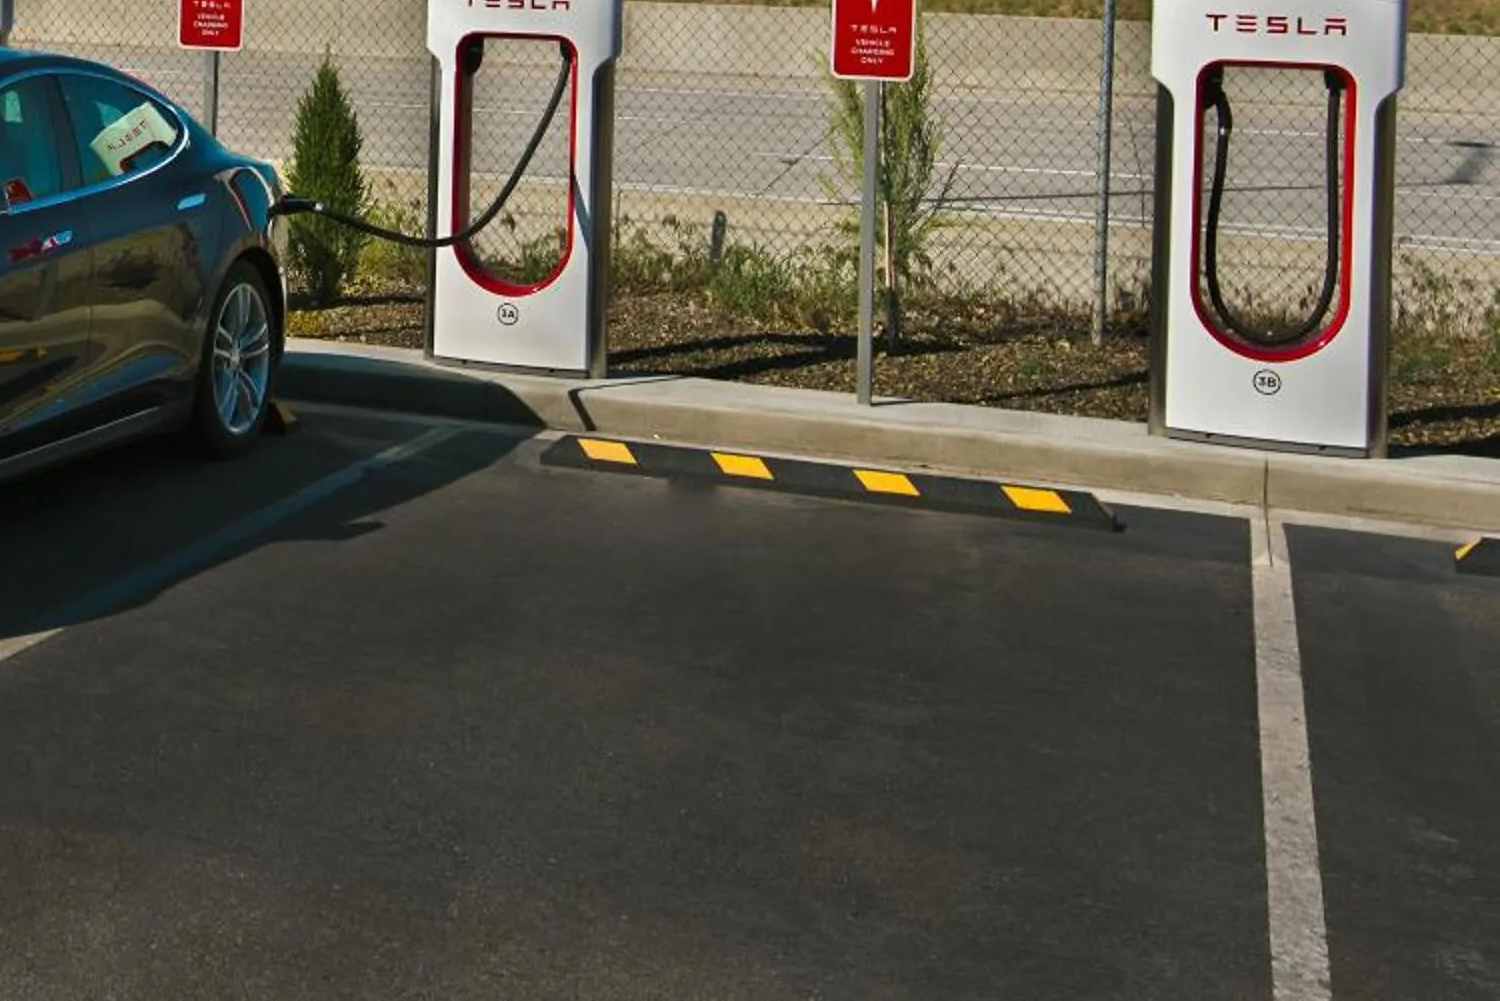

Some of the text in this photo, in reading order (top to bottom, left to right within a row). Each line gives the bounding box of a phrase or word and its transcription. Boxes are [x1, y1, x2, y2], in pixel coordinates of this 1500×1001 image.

[192, 0, 231, 9] TESLA
[850, 24, 897, 34] TESLA
[1205, 14, 1347, 36] TESLA
[855, 38, 890, 47] VEHICLE
[850, 47, 895, 56] CHARGING
[860, 56, 884, 64] ONLY
